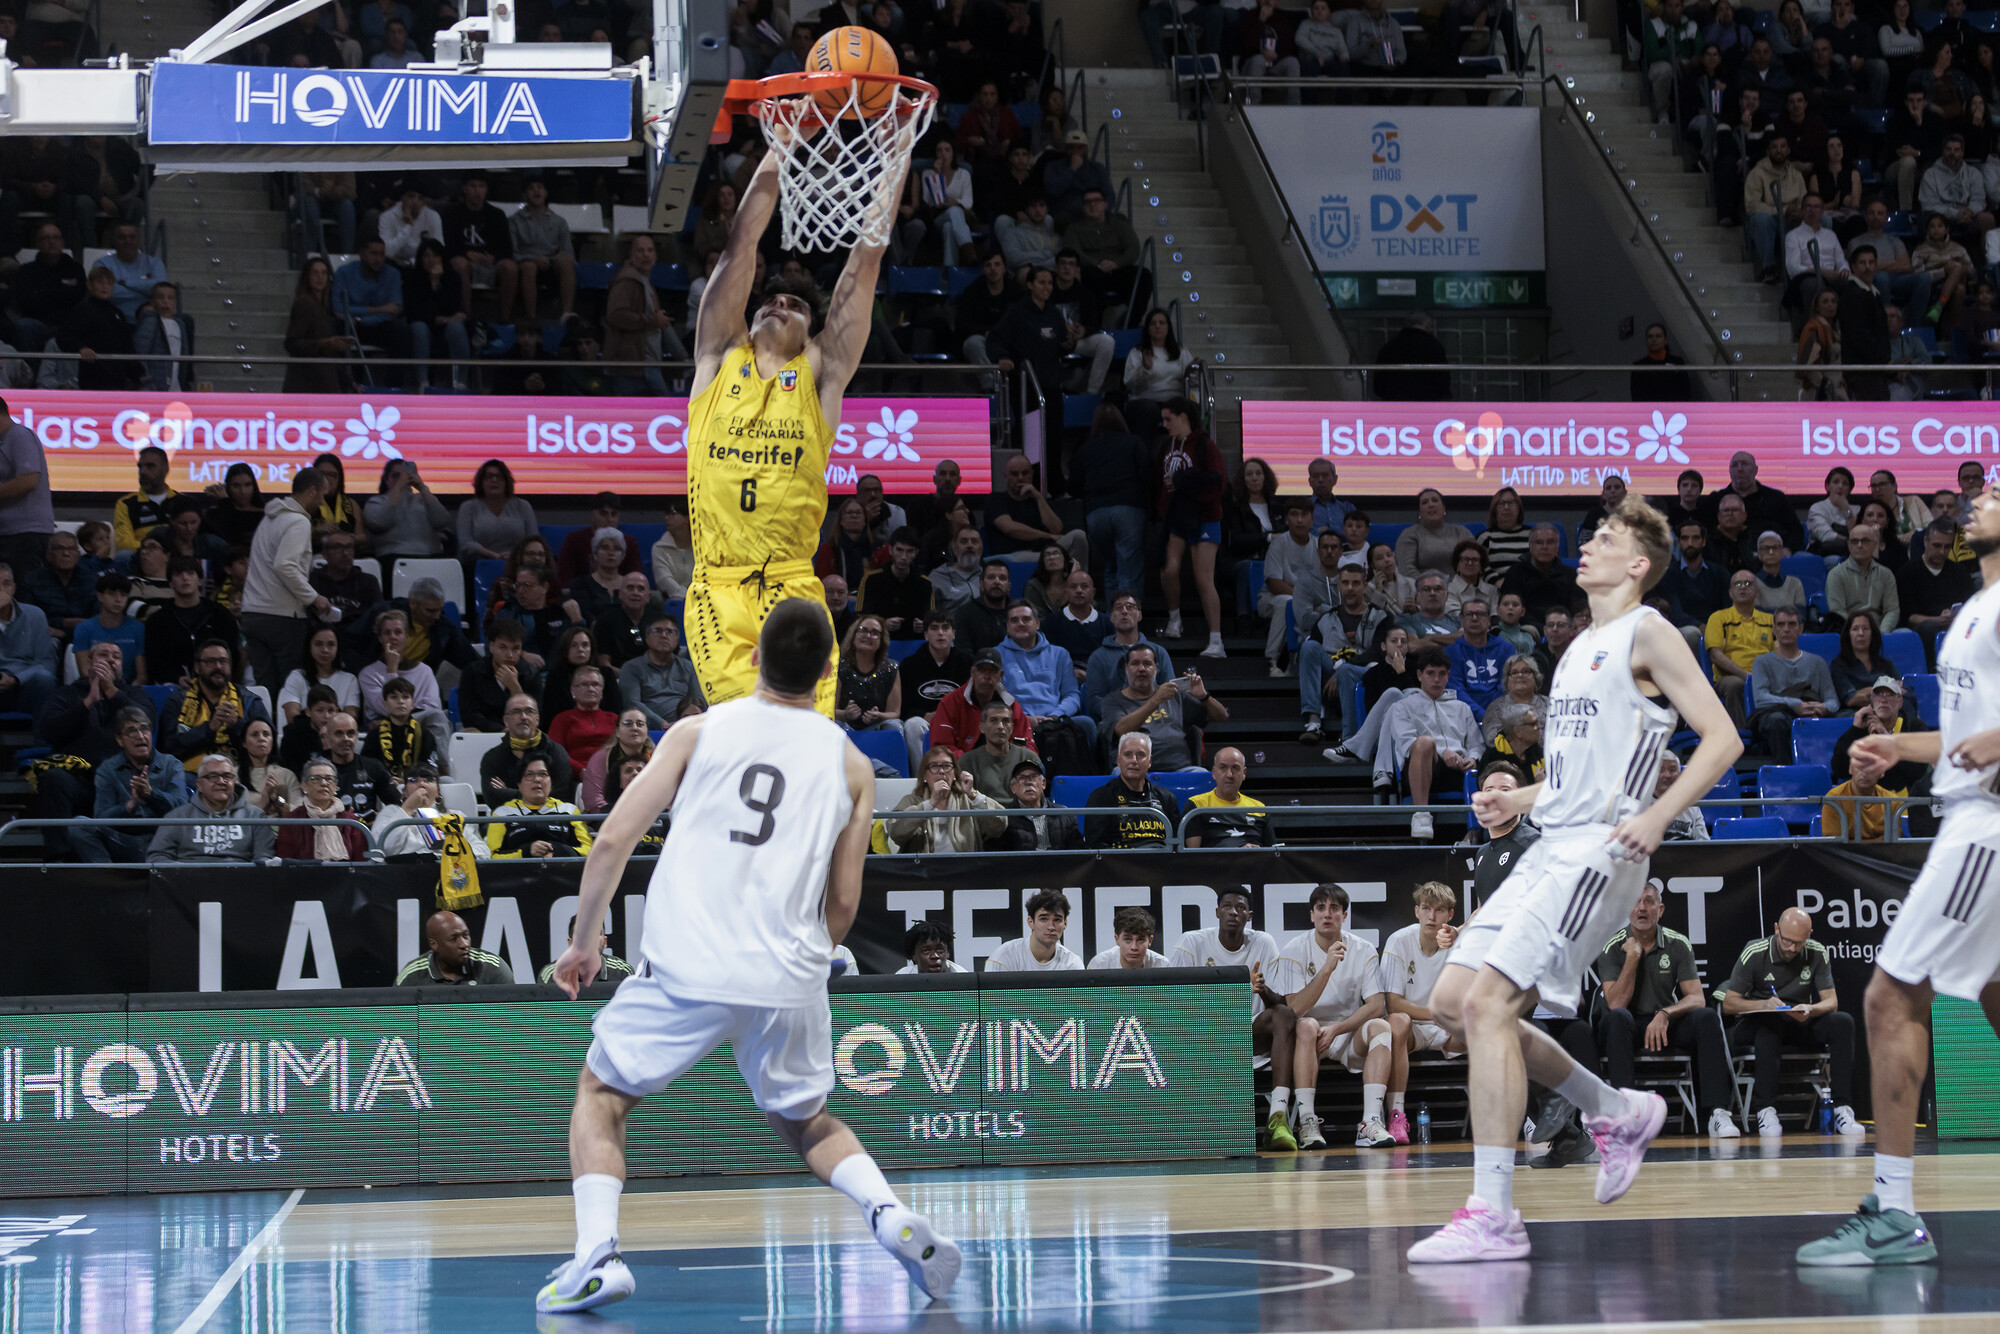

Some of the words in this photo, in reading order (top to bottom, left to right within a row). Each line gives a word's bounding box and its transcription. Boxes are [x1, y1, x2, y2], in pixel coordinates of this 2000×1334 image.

[235, 71, 548, 136] HOVIMA
[1372, 131, 1400, 163] 25
[1372, 165, 1401, 181] años
[1370, 194, 1477, 233] DXT
[1371, 237, 1480, 257] TENERIFE
[1445, 281, 1492, 299] EXIT
[10, 408, 98, 449] las
[112, 409, 337, 452] Canarias
[527, 414, 636, 454] Islas
[728, 426, 743, 436] CB
[1321, 419, 1422, 456] Islas
[1433, 418, 1631, 456] Canarias
[1802, 418, 1901, 456] Islas
[268, 463, 291, 482] DE
[1571, 467, 1590, 485] DE
[740, 478, 757, 512] 6
[730, 763, 786, 846] 9
[834, 1016, 1167, 1096] OVIMA
[2, 1036, 433, 1121] HOVIMA
[909, 1111, 1026, 1139] HOTELS
[160, 1133, 281, 1163] HOTELS
